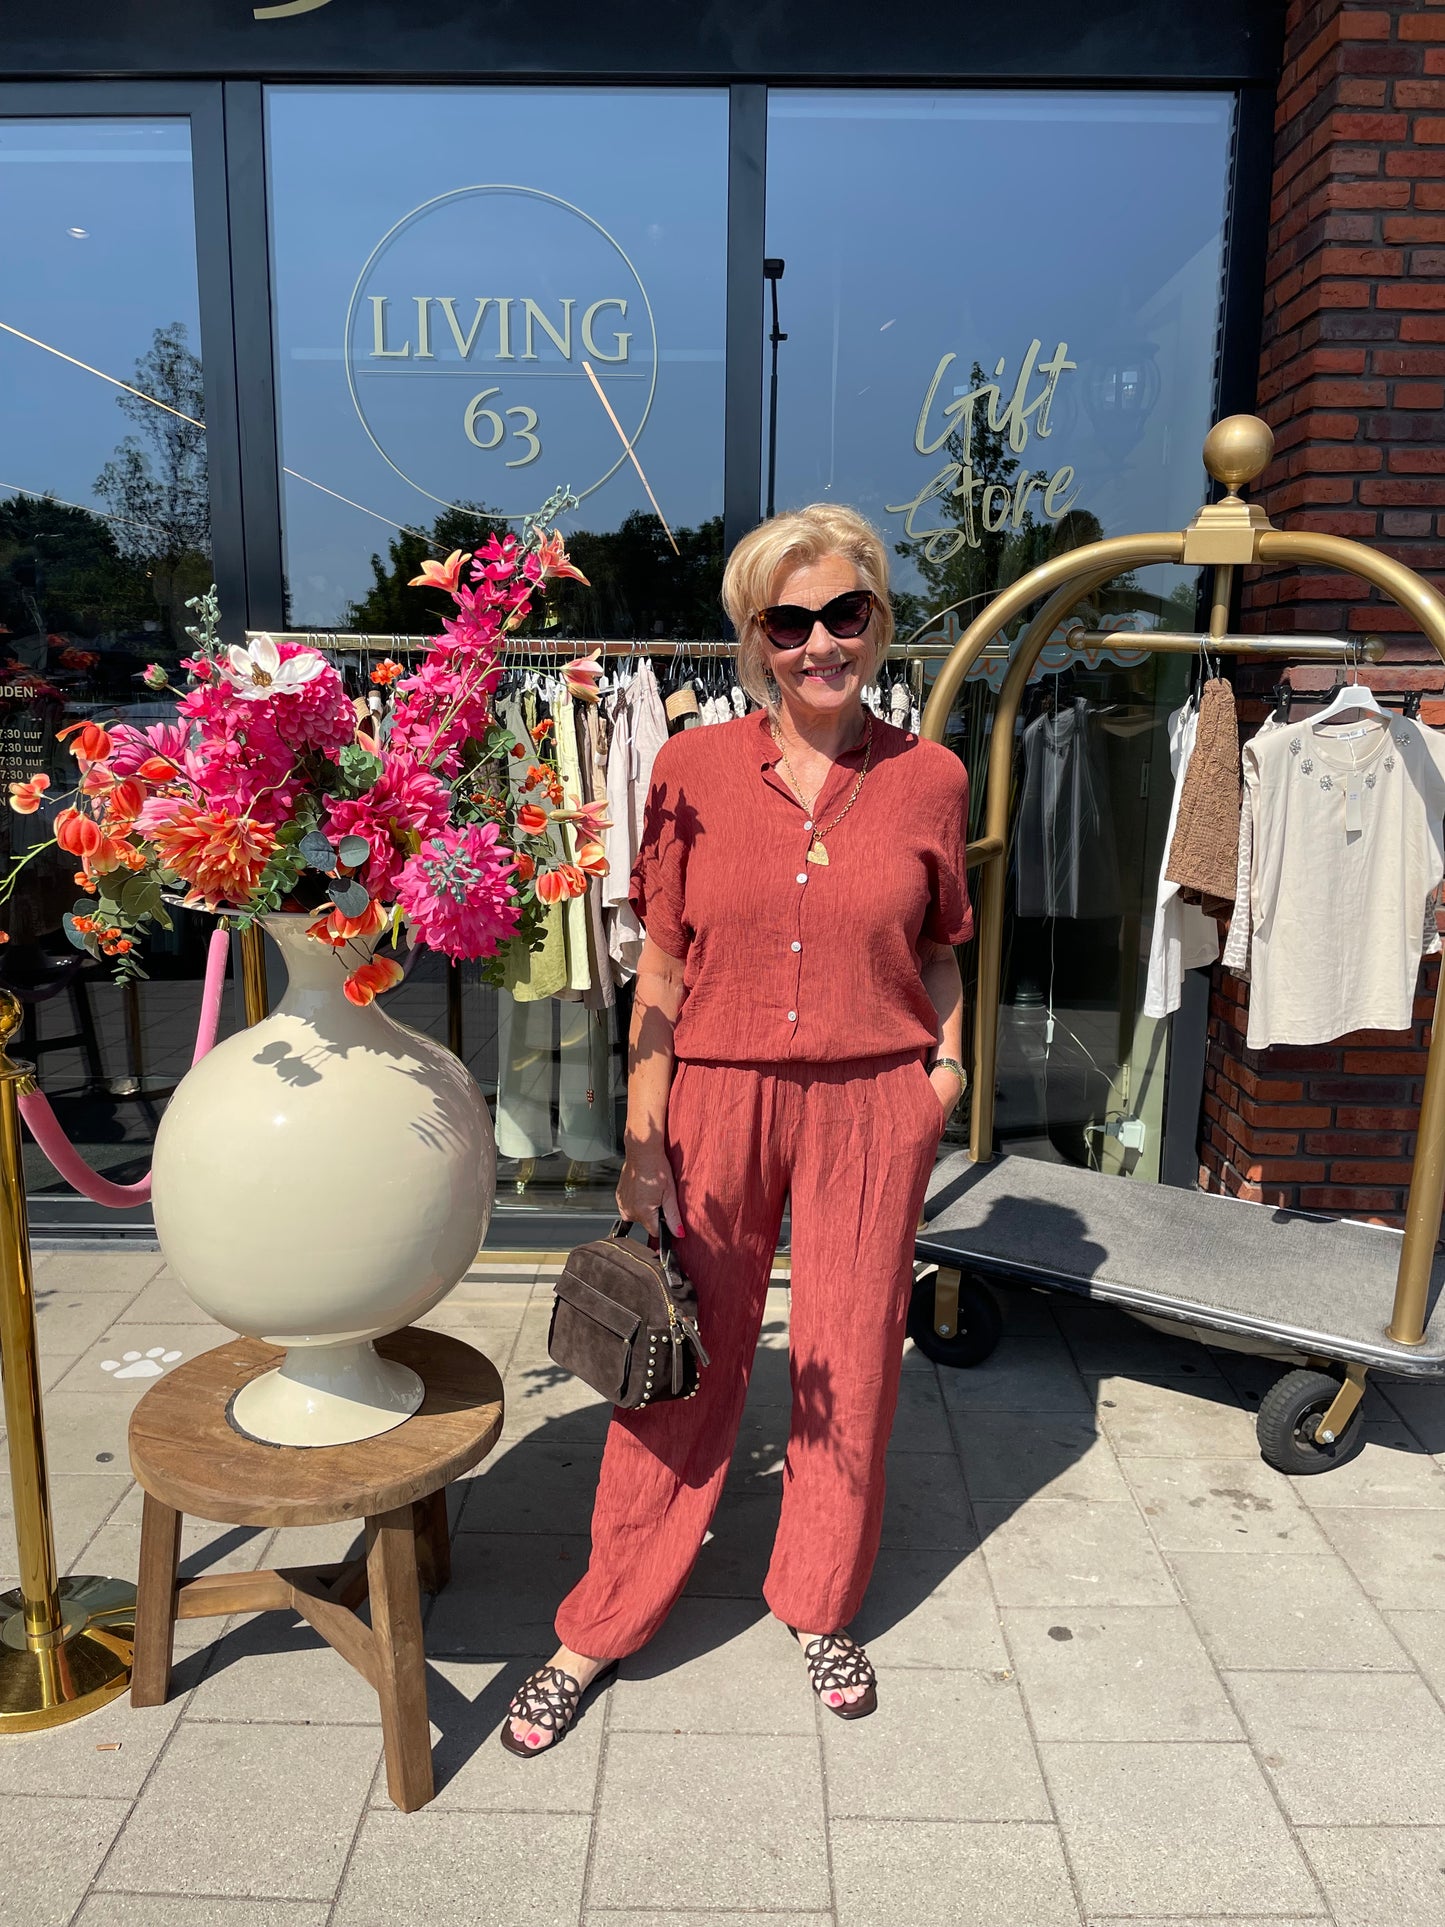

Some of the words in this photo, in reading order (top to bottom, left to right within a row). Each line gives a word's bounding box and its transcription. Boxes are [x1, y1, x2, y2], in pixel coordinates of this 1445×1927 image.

[367, 296, 633, 362] LIVING
[463, 387, 542, 467] 63
[915, 338, 1078, 466] Gift
[885, 463, 1084, 564] Store
[23, 731, 43, 739] uur
[24, 745, 44, 753] uur
[25, 759, 45, 767] uur
